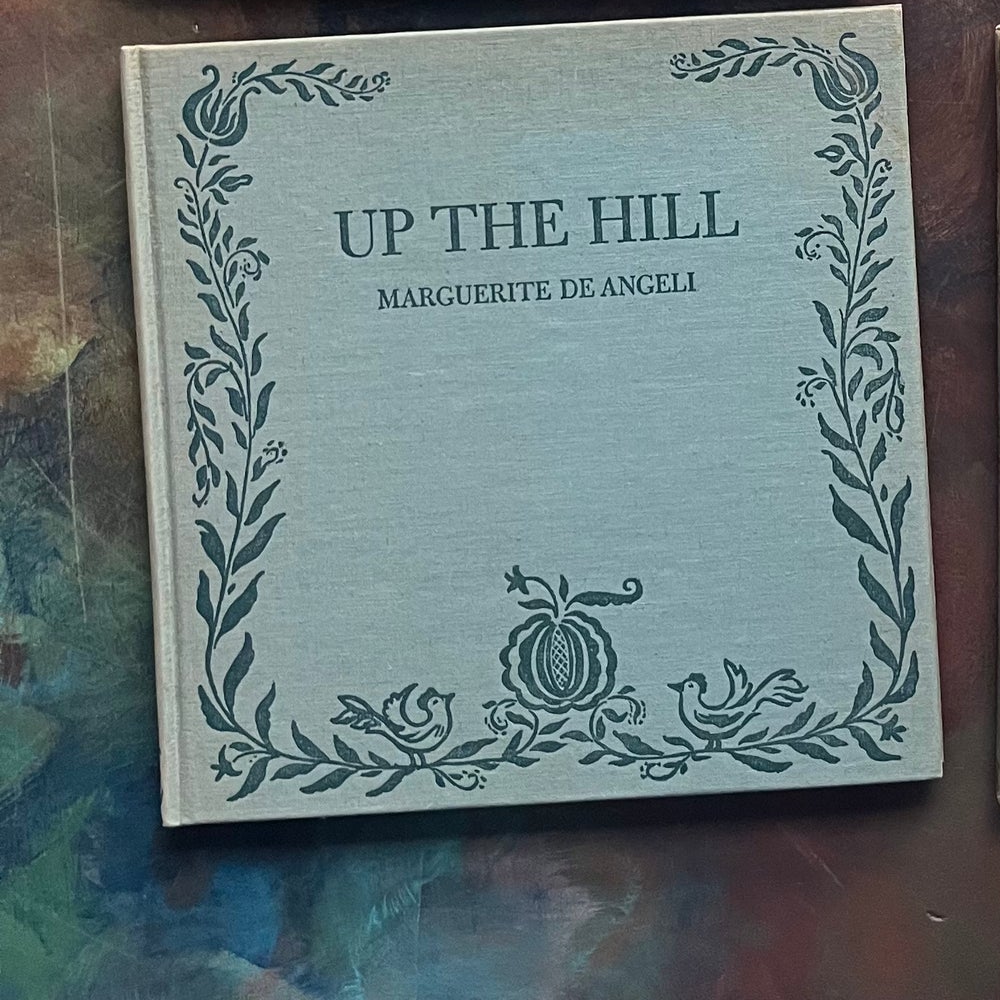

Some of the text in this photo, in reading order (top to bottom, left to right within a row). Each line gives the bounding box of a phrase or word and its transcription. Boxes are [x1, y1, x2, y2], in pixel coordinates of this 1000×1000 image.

[334, 190, 740, 258] UP THE HILL
[378, 270, 697, 310] MARGUERITE DE ANGELI
